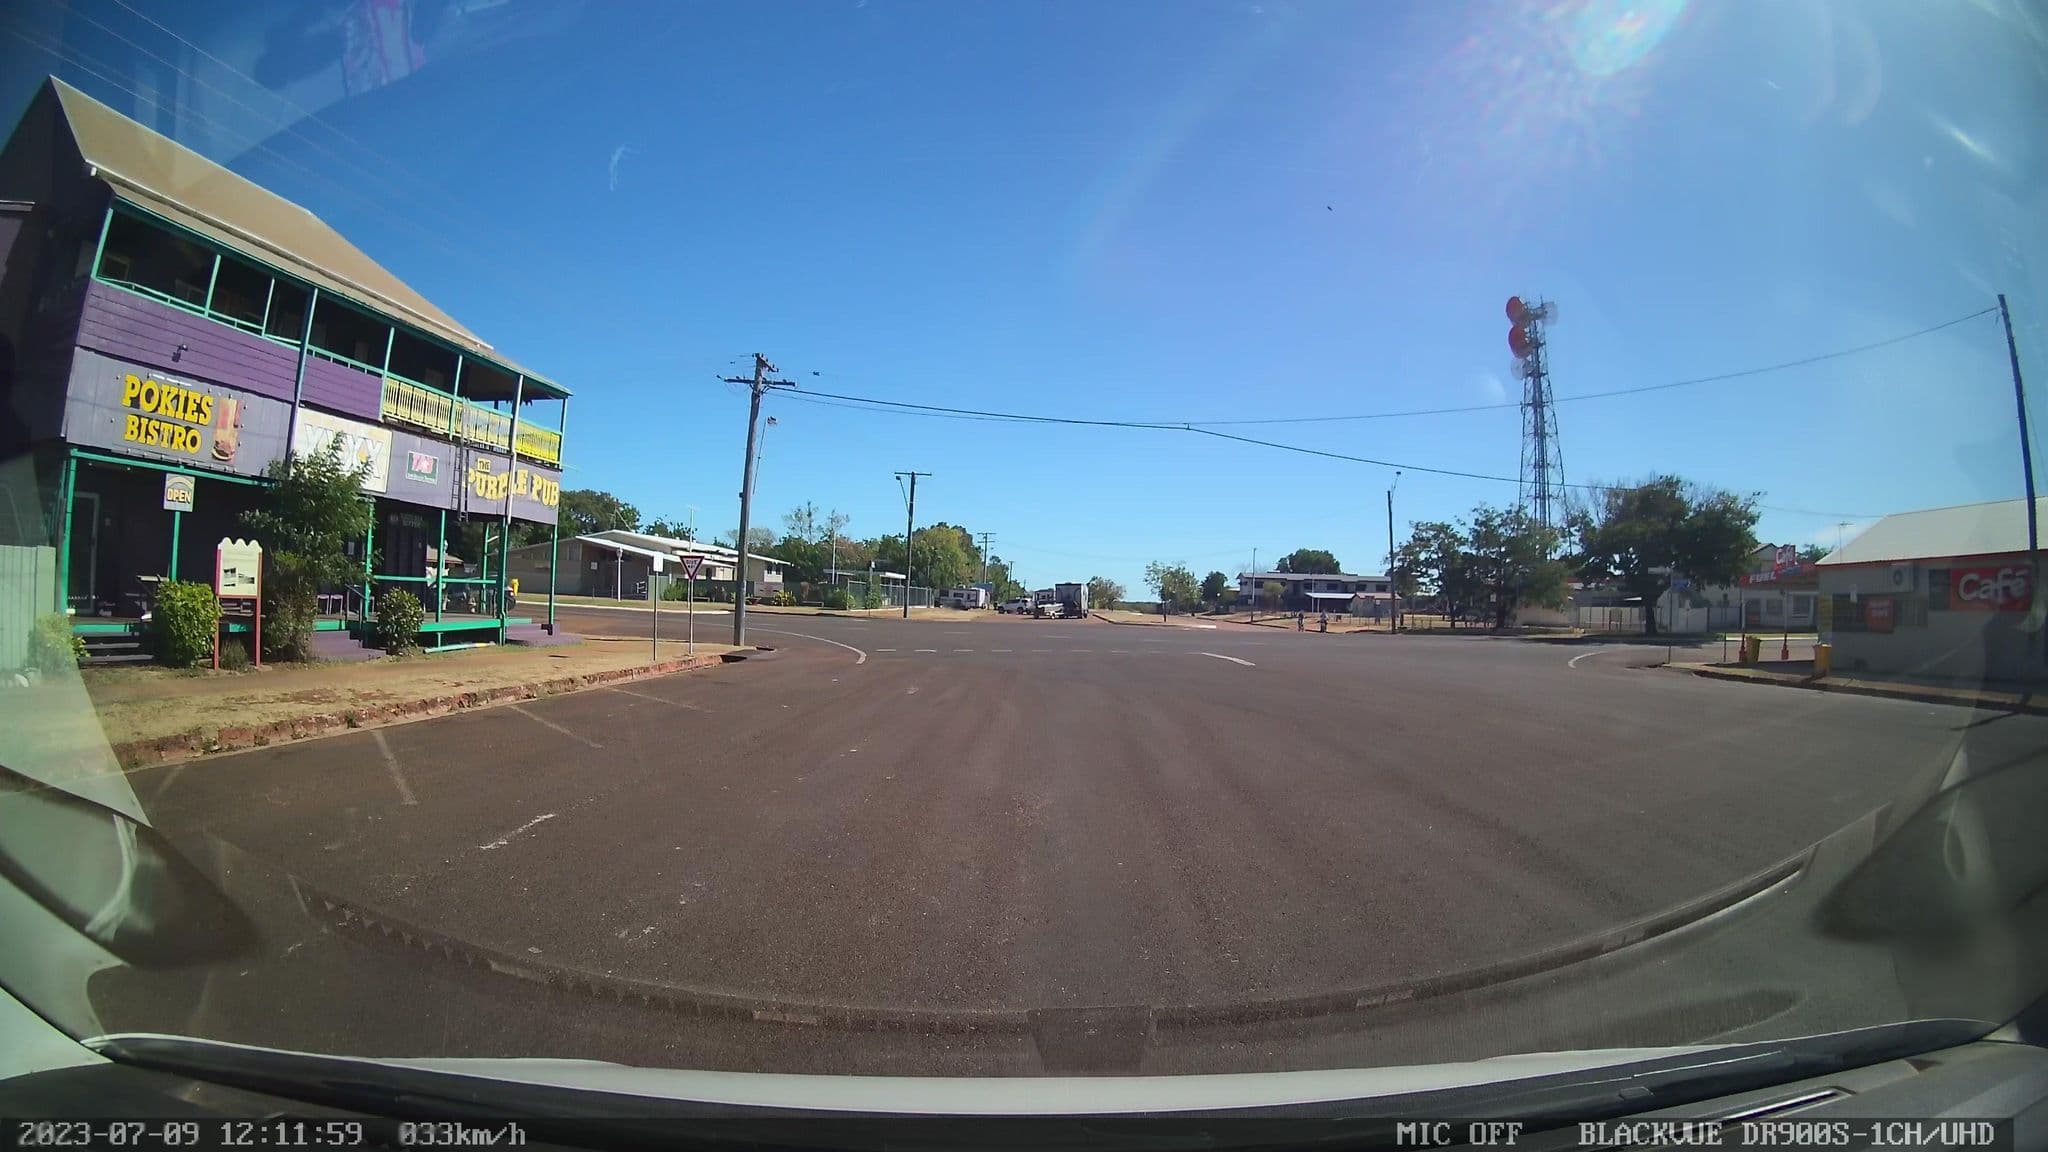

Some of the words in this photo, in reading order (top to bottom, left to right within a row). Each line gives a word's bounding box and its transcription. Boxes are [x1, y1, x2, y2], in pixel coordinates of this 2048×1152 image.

[121, 374, 214, 426] POKIES
[123, 414, 203, 454] BISTRO
[478, 459, 490, 471] THE
[167, 488, 192, 504] OPEN
[532, 473, 559, 507] PUB
[1958, 566, 2028, 605] Café
